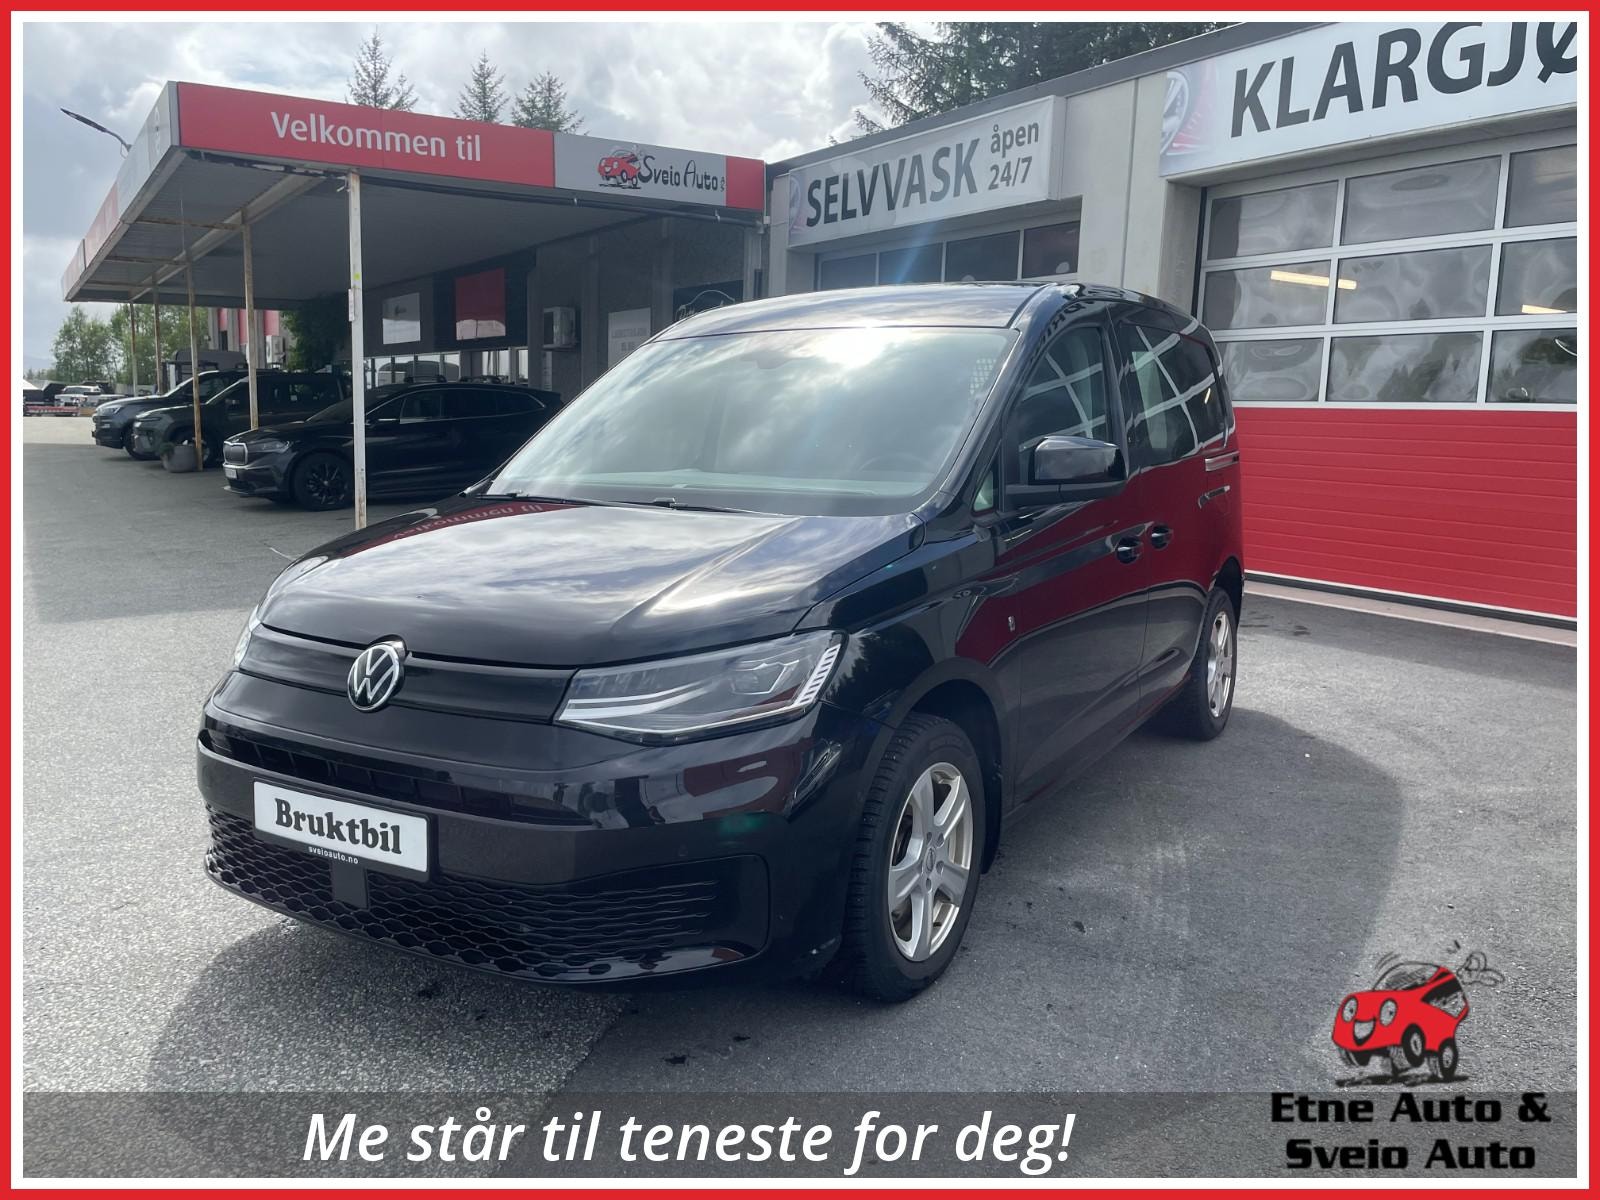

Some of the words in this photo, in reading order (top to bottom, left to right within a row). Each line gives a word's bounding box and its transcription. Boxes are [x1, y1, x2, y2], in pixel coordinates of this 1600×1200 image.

[271, 111, 446, 158] Velkommen
[456, 134, 481, 162] til
[990, 122, 1039, 158] åpen
[638, 155, 681, 187] Sveio
[683, 160, 718, 191] Auto
[806, 138, 980, 227] SELVVASK
[988, 156, 1033, 191] 24/7
[275, 798, 402, 855] Bruktbil
[308, 846, 359, 865] sveioauto.no
